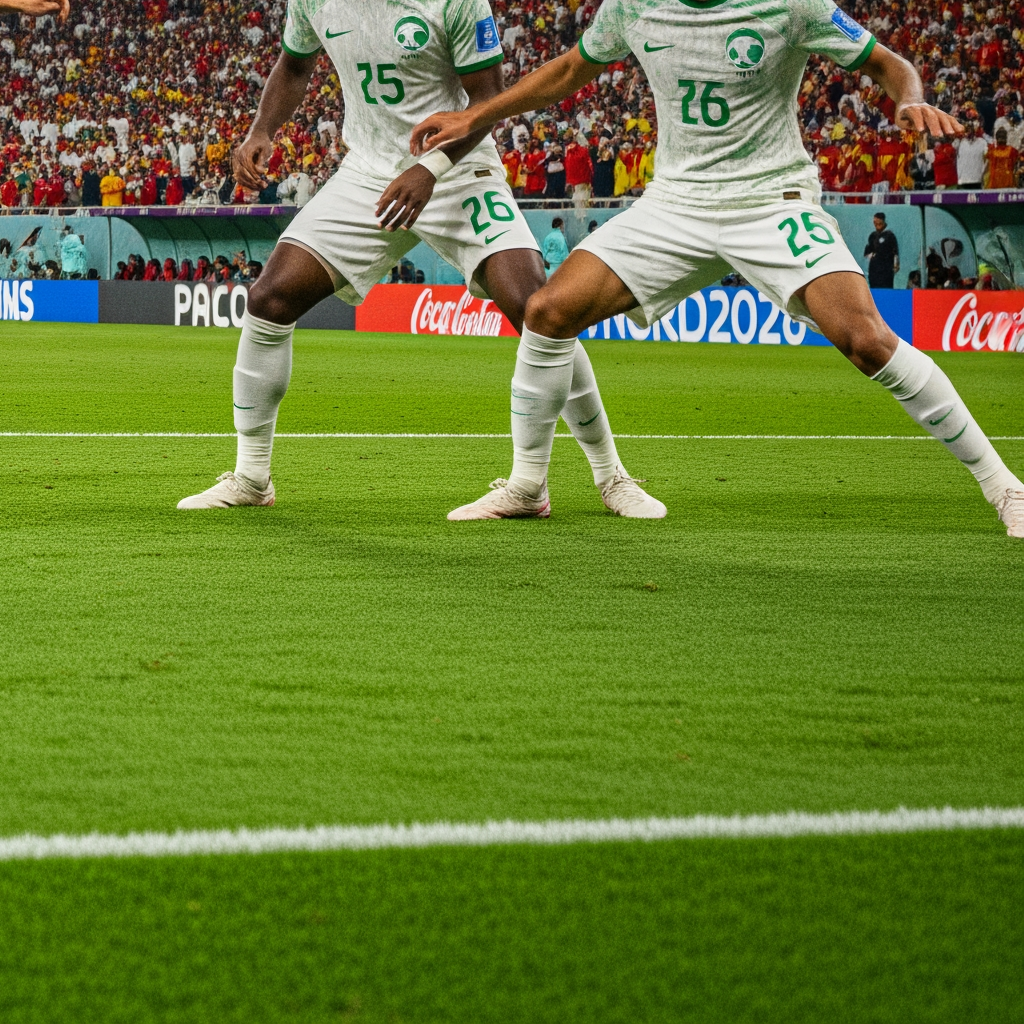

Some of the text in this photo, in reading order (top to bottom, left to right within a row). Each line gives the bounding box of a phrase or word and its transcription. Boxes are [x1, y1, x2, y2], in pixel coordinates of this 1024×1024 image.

[356, 62, 405, 105] 25
[678, 79, 730, 127] 26
[461, 190, 515, 235] 26
[777, 212, 835, 257] 25
